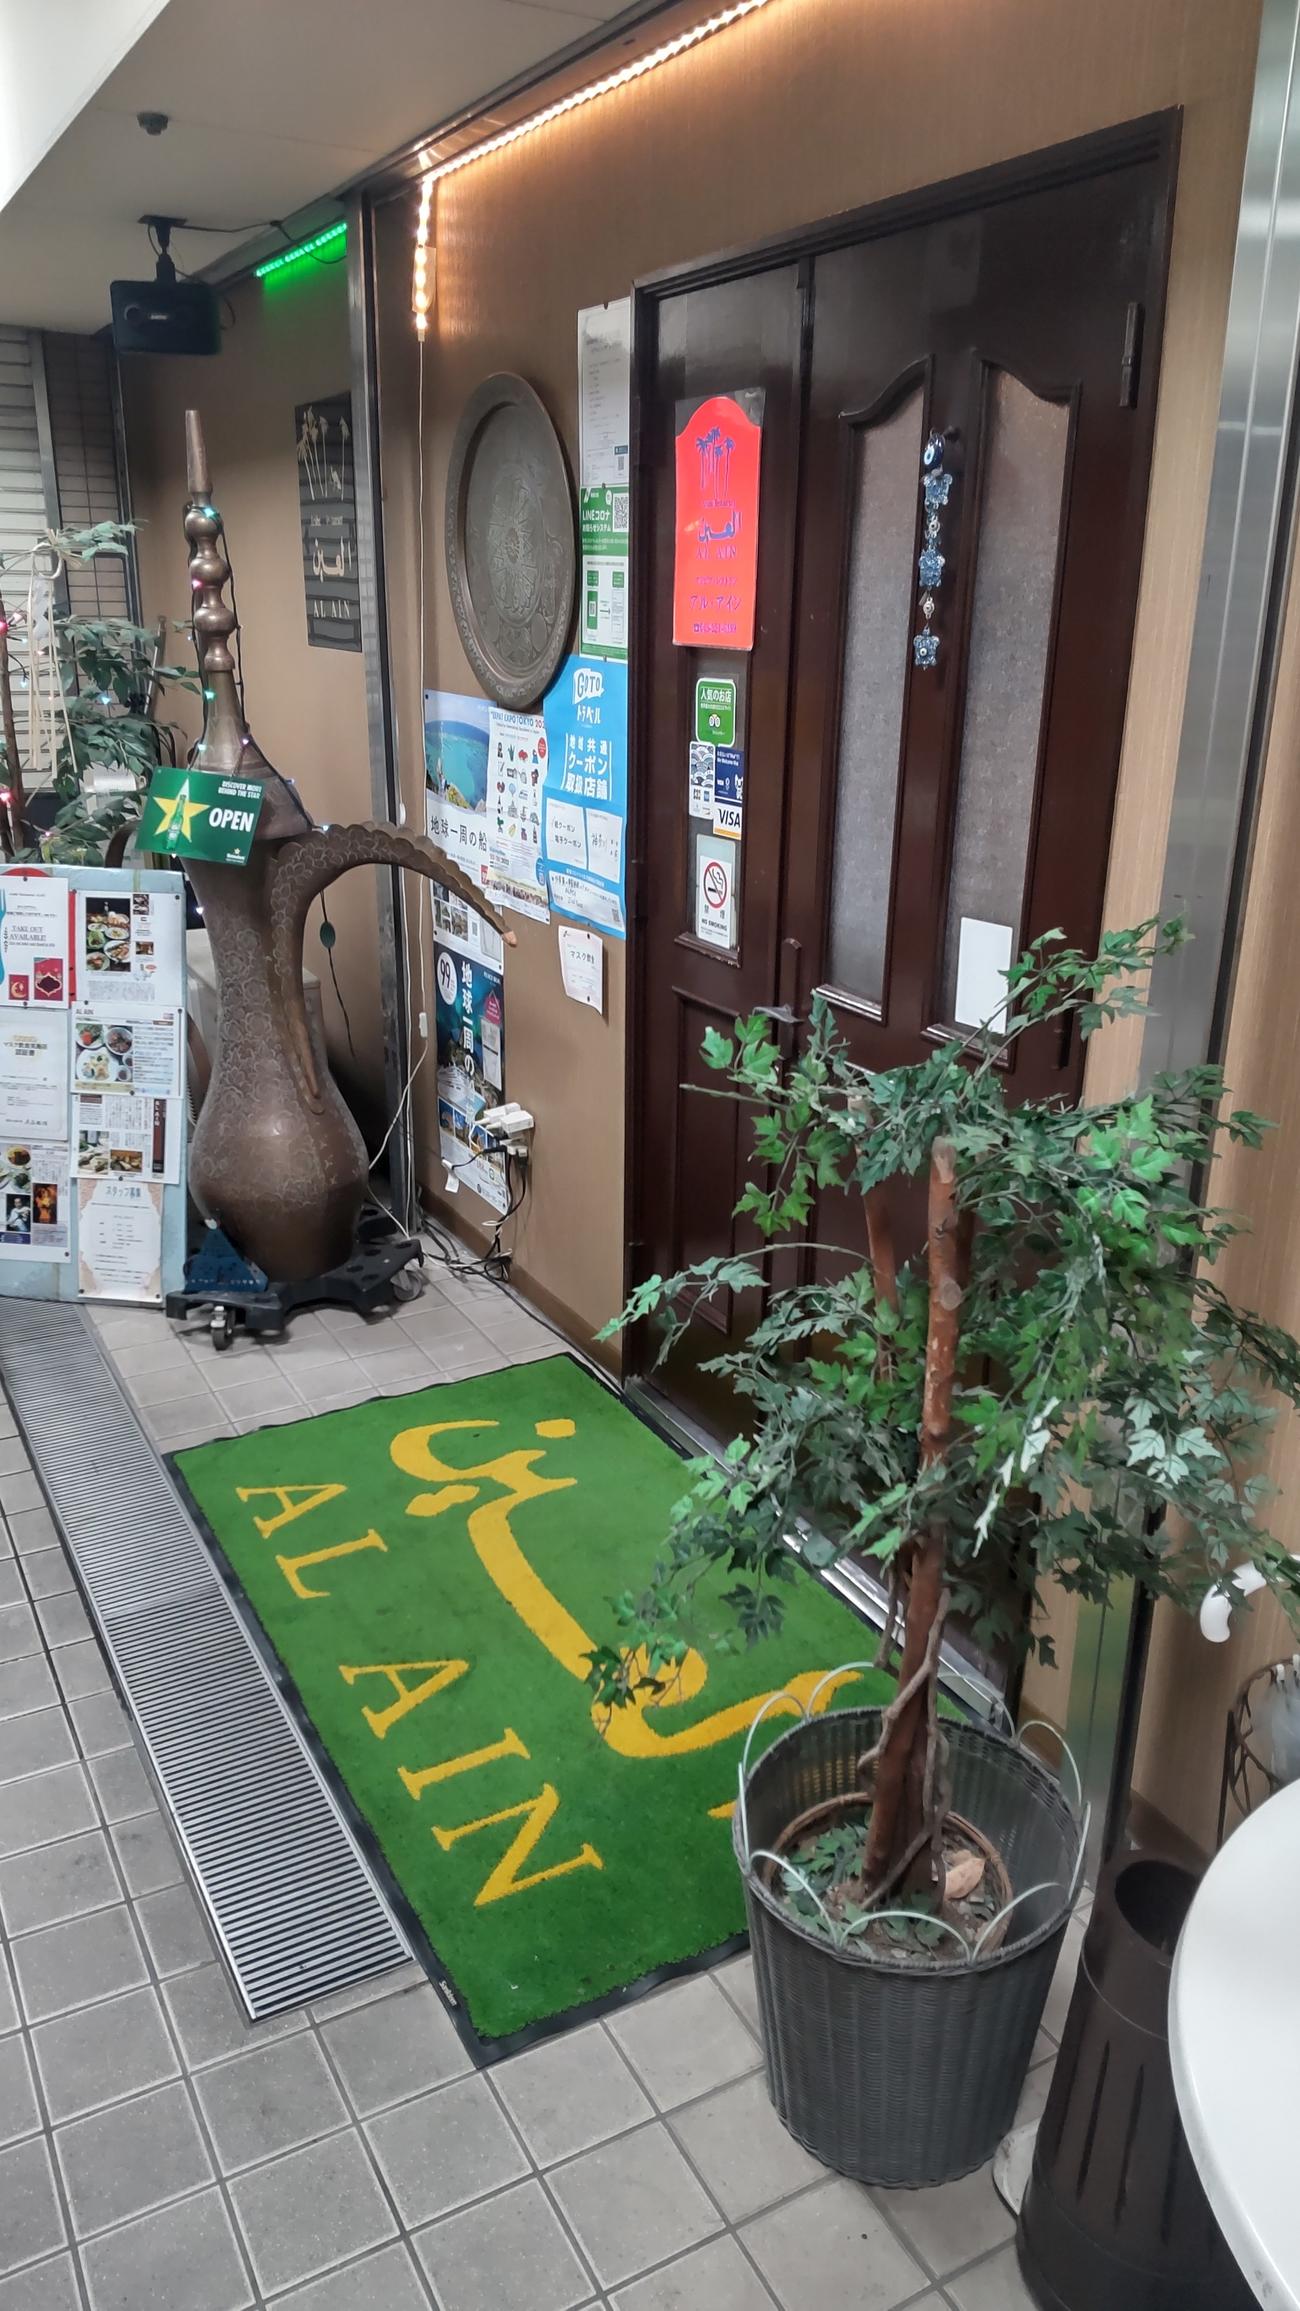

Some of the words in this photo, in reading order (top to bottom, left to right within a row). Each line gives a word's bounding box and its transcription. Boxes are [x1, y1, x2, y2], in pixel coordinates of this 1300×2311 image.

[312, 536, 352, 583] العين
[313, 600, 326, 618] AL
[331, 600, 351, 618] AIN
[700, 687, 732, 703] 人気のお店
[576, 704, 601, 725] トラベル
[568, 734, 608, 756] 地域共通
[568, 752, 608, 776] クーポン
[247, 790, 261, 799] STAR
[565, 772, 608, 800] 取扱店舗
[208, 807, 254, 832] OPEN
[718, 808, 741, 828] VISA
[430, 815, 488, 853] 地球一周の船
[11, 925, 28, 933] TAKE
[708, 921, 728, 931] SMOKING
[440, 959, 451, 989] 99
[236, 1483, 387, 1599] AL
[339, 1658, 604, 1909] AIN
